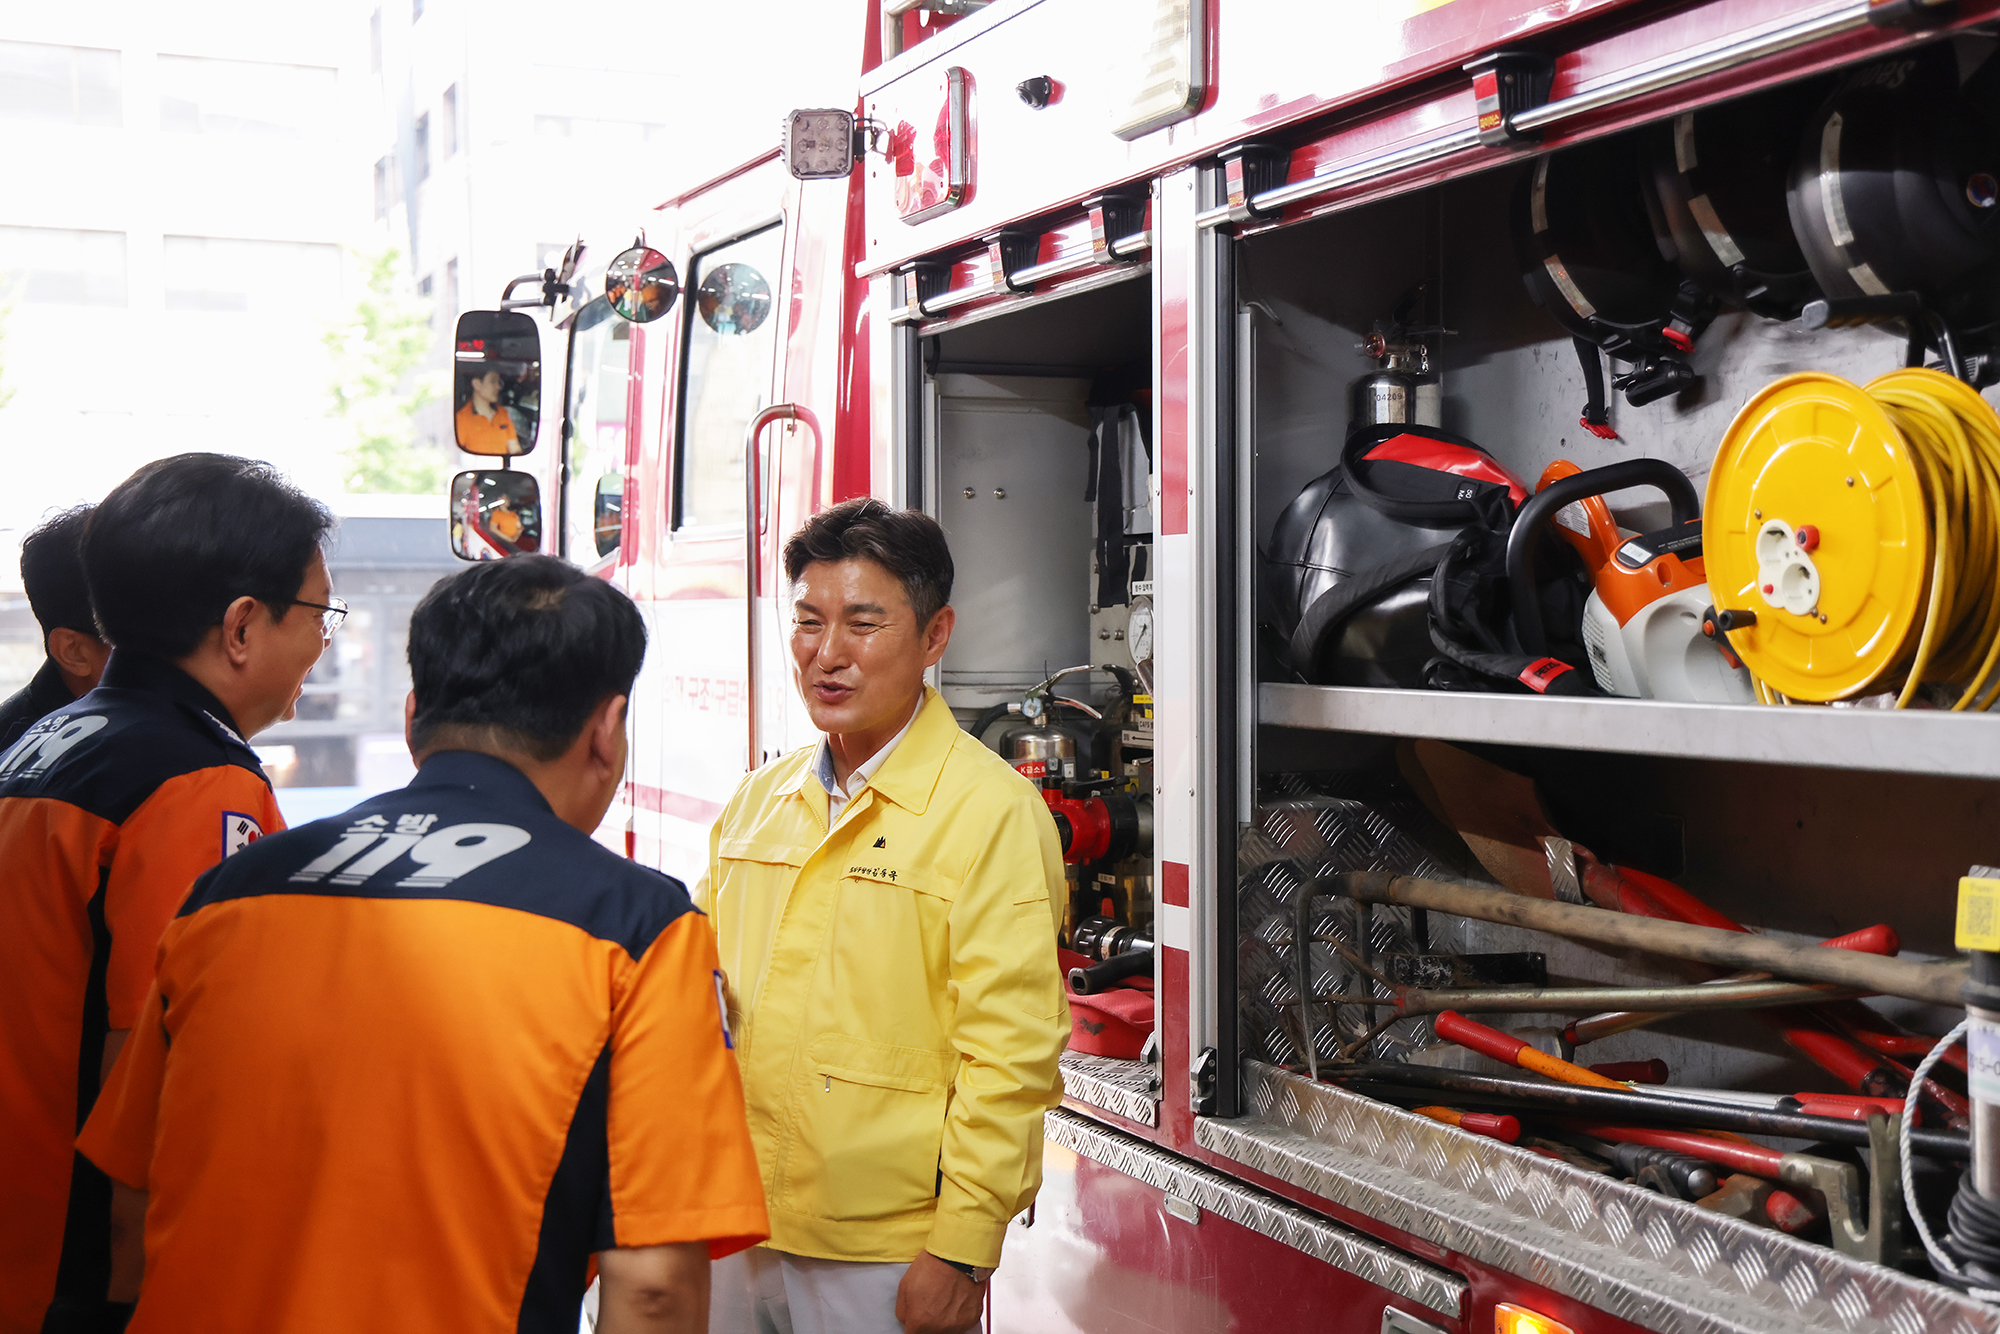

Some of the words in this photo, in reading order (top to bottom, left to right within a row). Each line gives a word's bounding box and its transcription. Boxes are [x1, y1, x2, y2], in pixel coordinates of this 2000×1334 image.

[30, 714, 70, 734] 소방
[346, 813, 438, 834] 소방
[288, 822, 532, 888] 119
